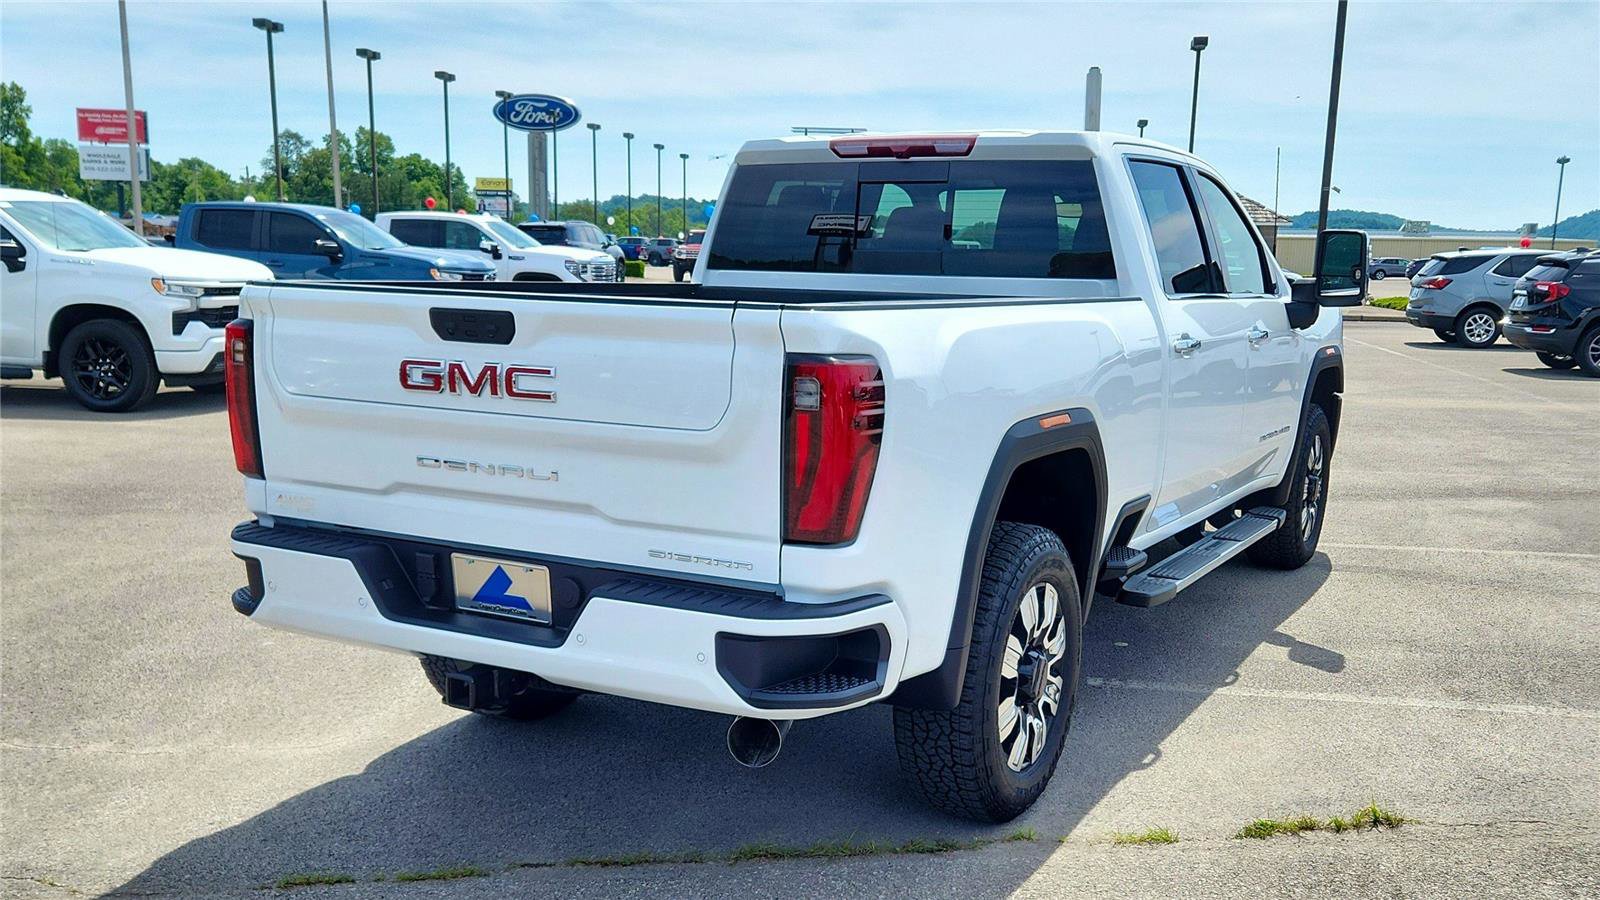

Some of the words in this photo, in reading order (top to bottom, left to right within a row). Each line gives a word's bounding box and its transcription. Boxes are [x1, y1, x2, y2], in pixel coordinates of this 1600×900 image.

[510, 101, 562, 123] Ford
[399, 357, 557, 403] GMC
[416, 455, 559, 482] DENALI
[648, 550, 753, 570] SIERRA
